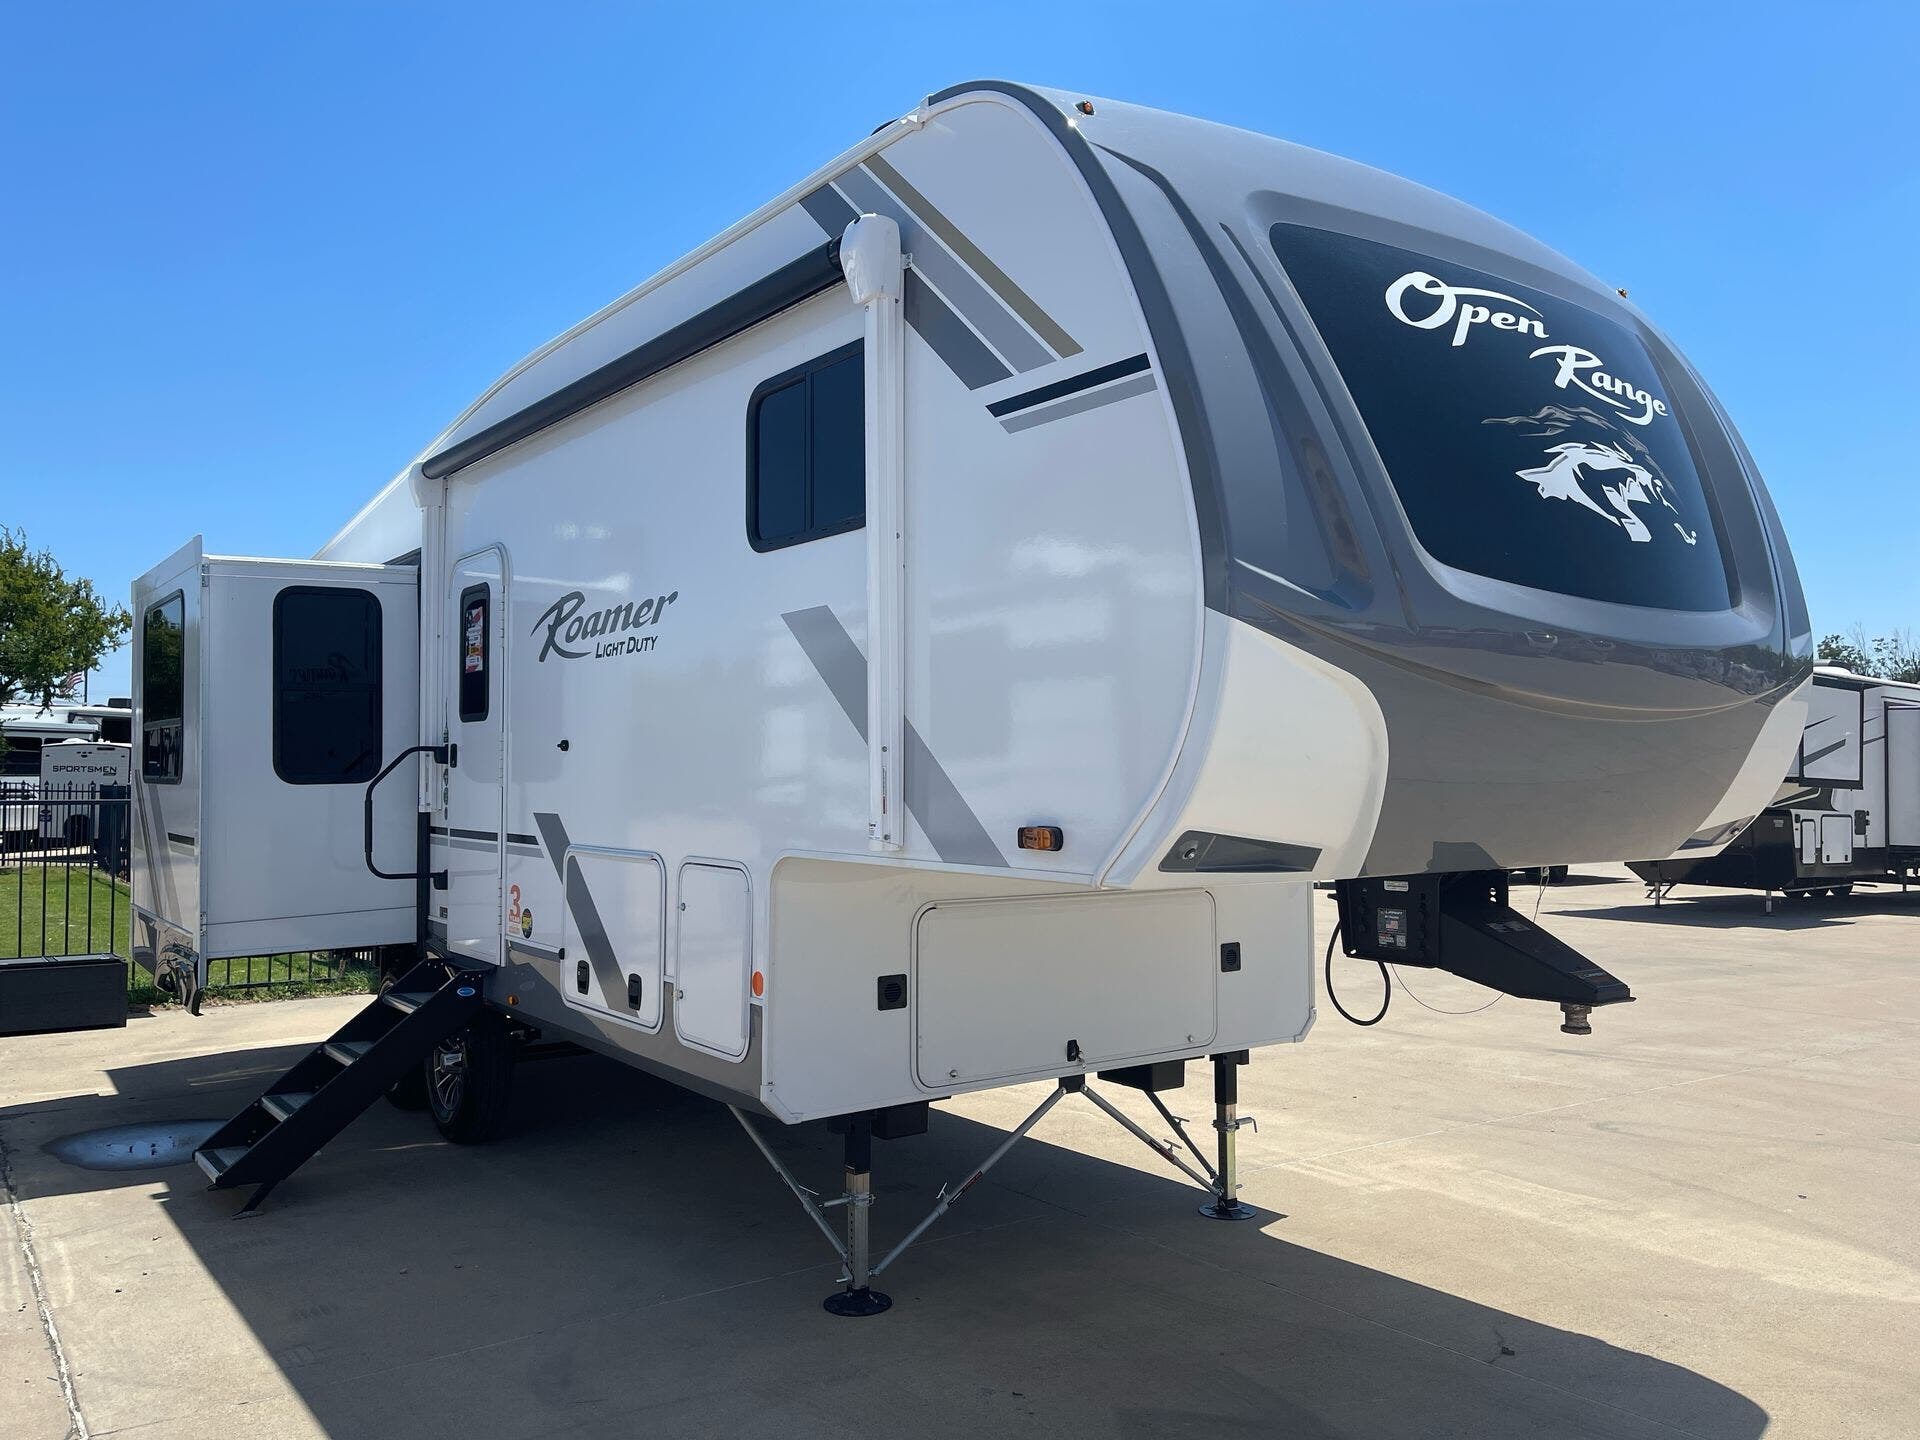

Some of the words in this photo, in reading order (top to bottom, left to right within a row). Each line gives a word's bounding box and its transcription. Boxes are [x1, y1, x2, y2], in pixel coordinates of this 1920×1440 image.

[1385, 271, 1549, 346] Open
[1529, 345, 1669, 426] Range
[530, 591, 679, 663] Roamer
[595, 641, 626, 659] LIGHT
[626, 635, 659, 654] DUTY
[52, 765, 118, 773] SPORTSMEN
[510, 885, 521, 917] 3
